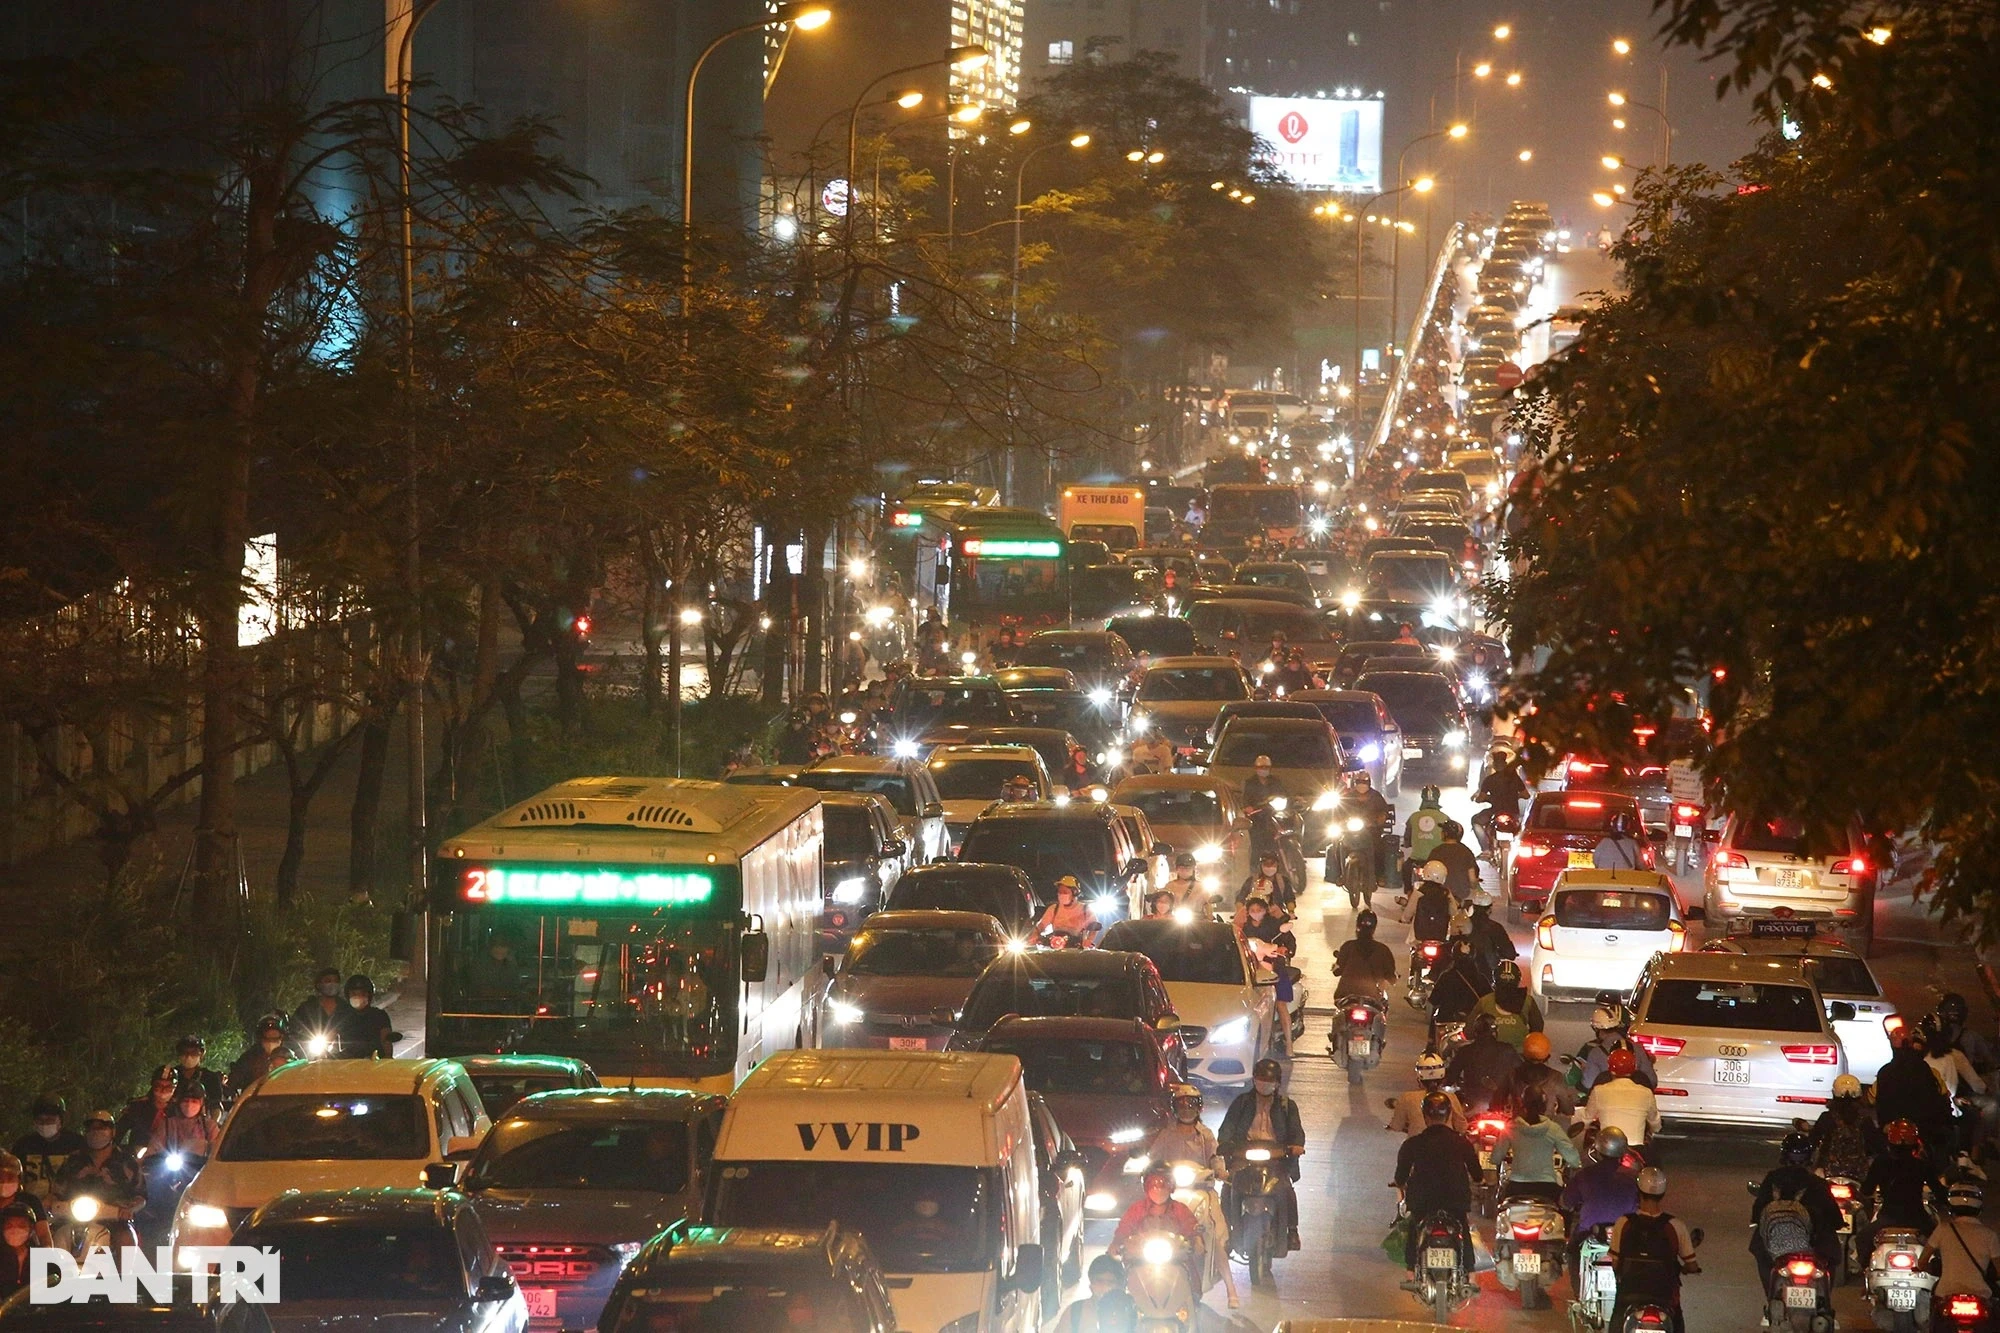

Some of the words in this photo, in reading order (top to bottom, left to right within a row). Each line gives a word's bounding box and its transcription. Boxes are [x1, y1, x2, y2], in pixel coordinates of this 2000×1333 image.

[1077, 495, 1087, 504] XE
[1723, 1060, 1742, 1072] 30G
[795, 1122, 920, 1152] VVIP
[509, 1261, 599, 1276] ORD
[522, 1292, 542, 1304] 0G
